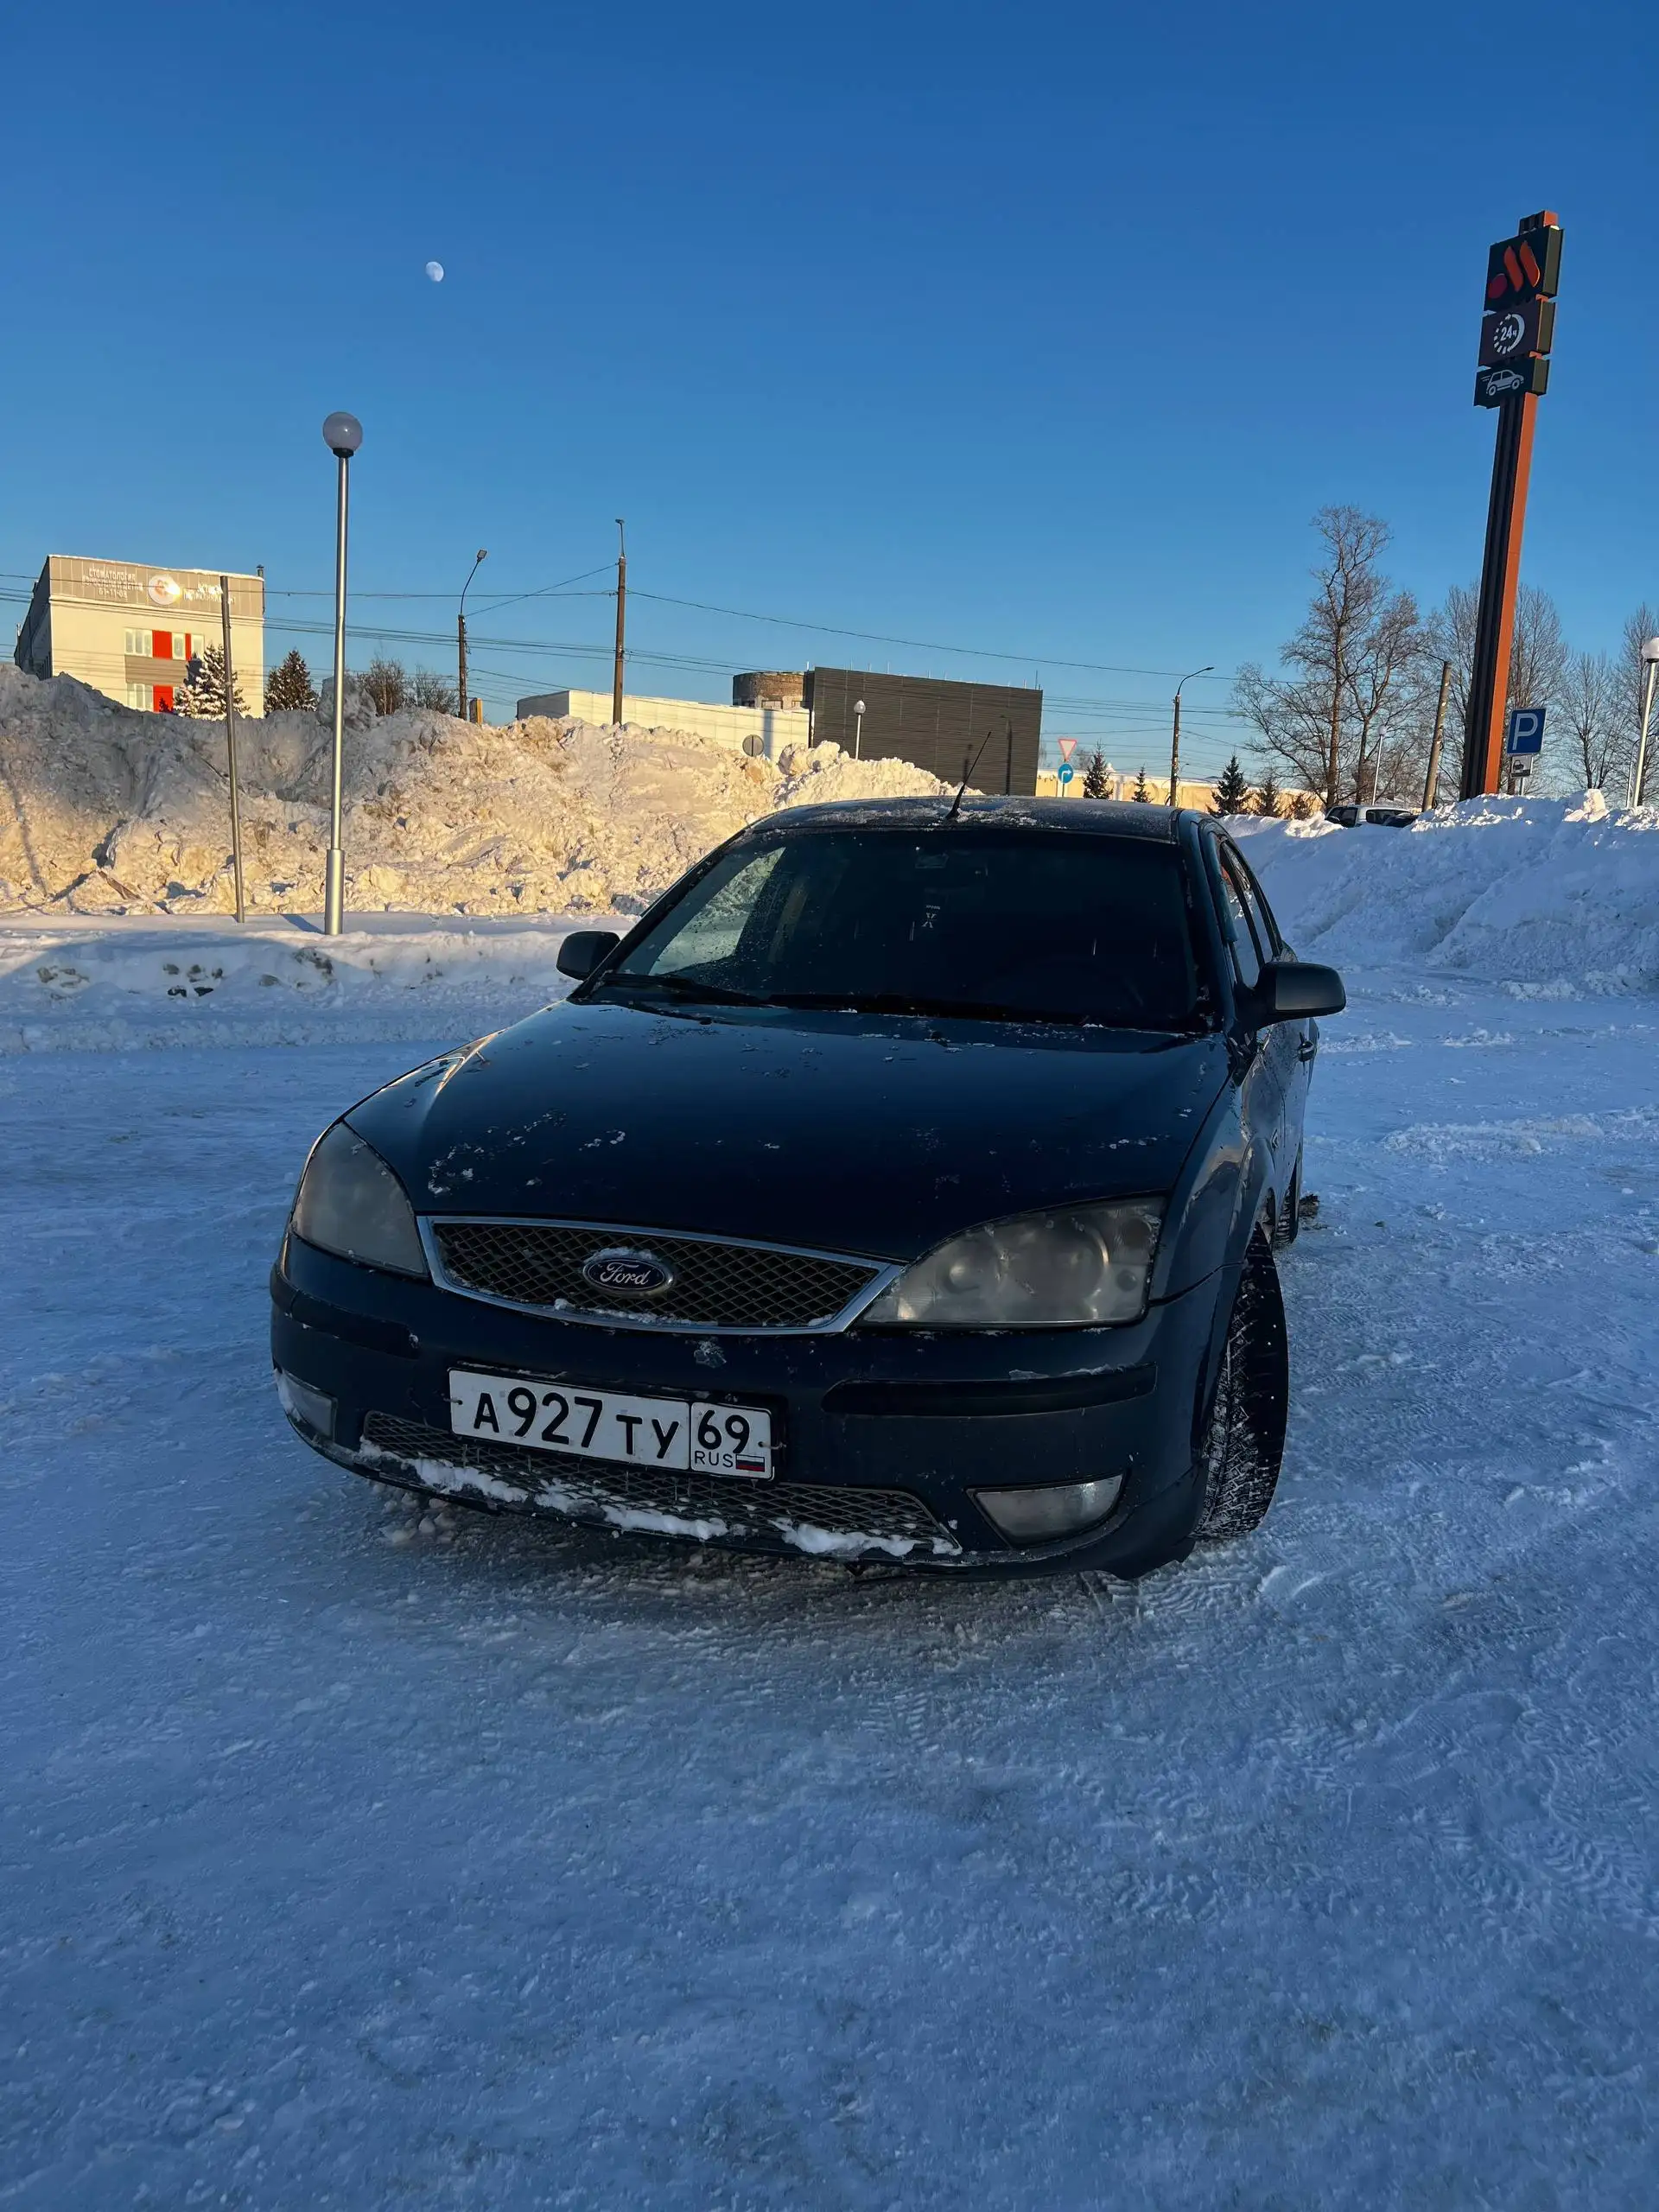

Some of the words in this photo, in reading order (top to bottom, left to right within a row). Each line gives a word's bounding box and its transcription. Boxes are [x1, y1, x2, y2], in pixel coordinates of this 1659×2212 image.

[1512, 713, 1538, 751] P
[600, 1262, 652, 1286] Ford
[697, 1409, 750, 1454] 69
[694, 1450, 734, 1468] RUS
